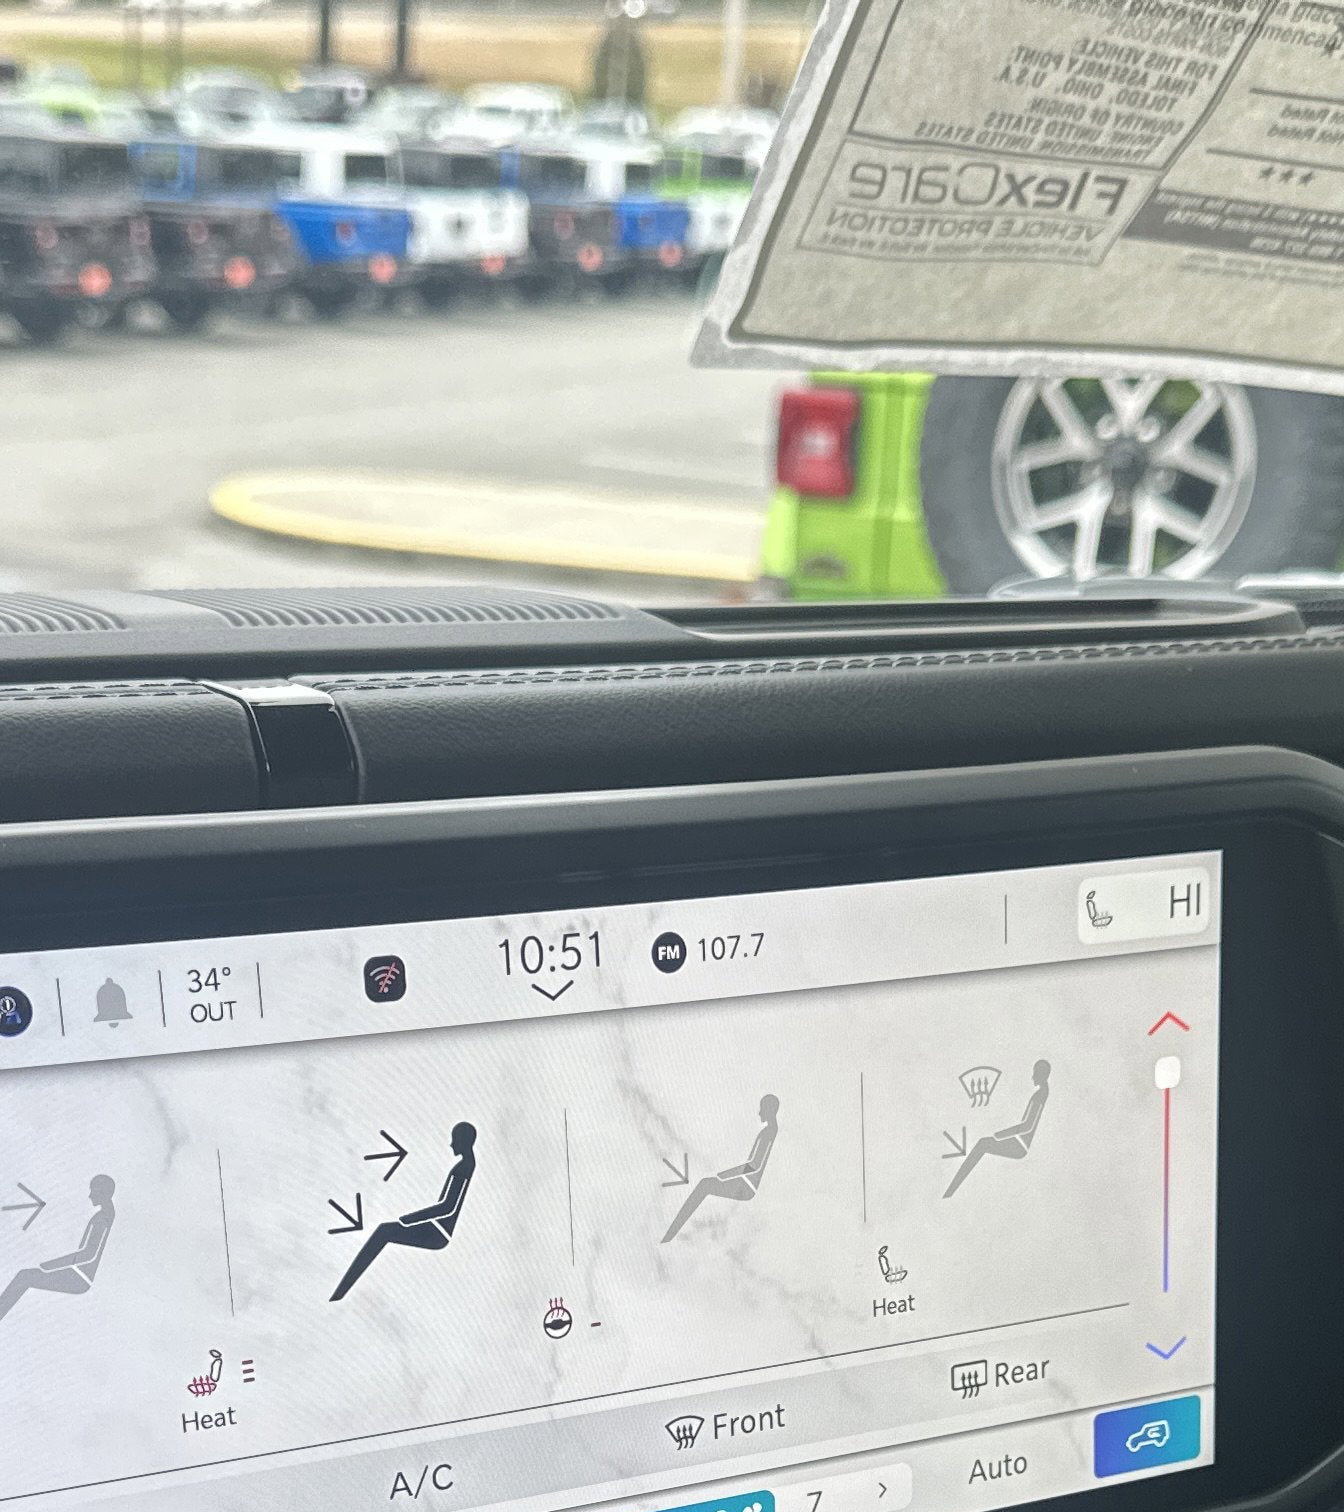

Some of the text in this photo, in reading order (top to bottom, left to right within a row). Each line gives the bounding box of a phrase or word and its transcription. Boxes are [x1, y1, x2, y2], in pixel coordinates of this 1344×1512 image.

[1168, 882, 1203, 919] HI
[498, 930, 602, 976] 10:51
[657, 932, 765, 963] FM 107.7
[187, 966, 232, 994] 34°
[190, 1000, 238, 1023] OUT
[872, 1293, 916, 1318] Heat
[993, 1356, 1050, 1388] Rear
[181, 1406, 238, 1434] Heat
[712, 1402, 786, 1440] Front
[389, 1463, 455, 1501] A/C
[968, 1451, 1029, 1485] Auto
